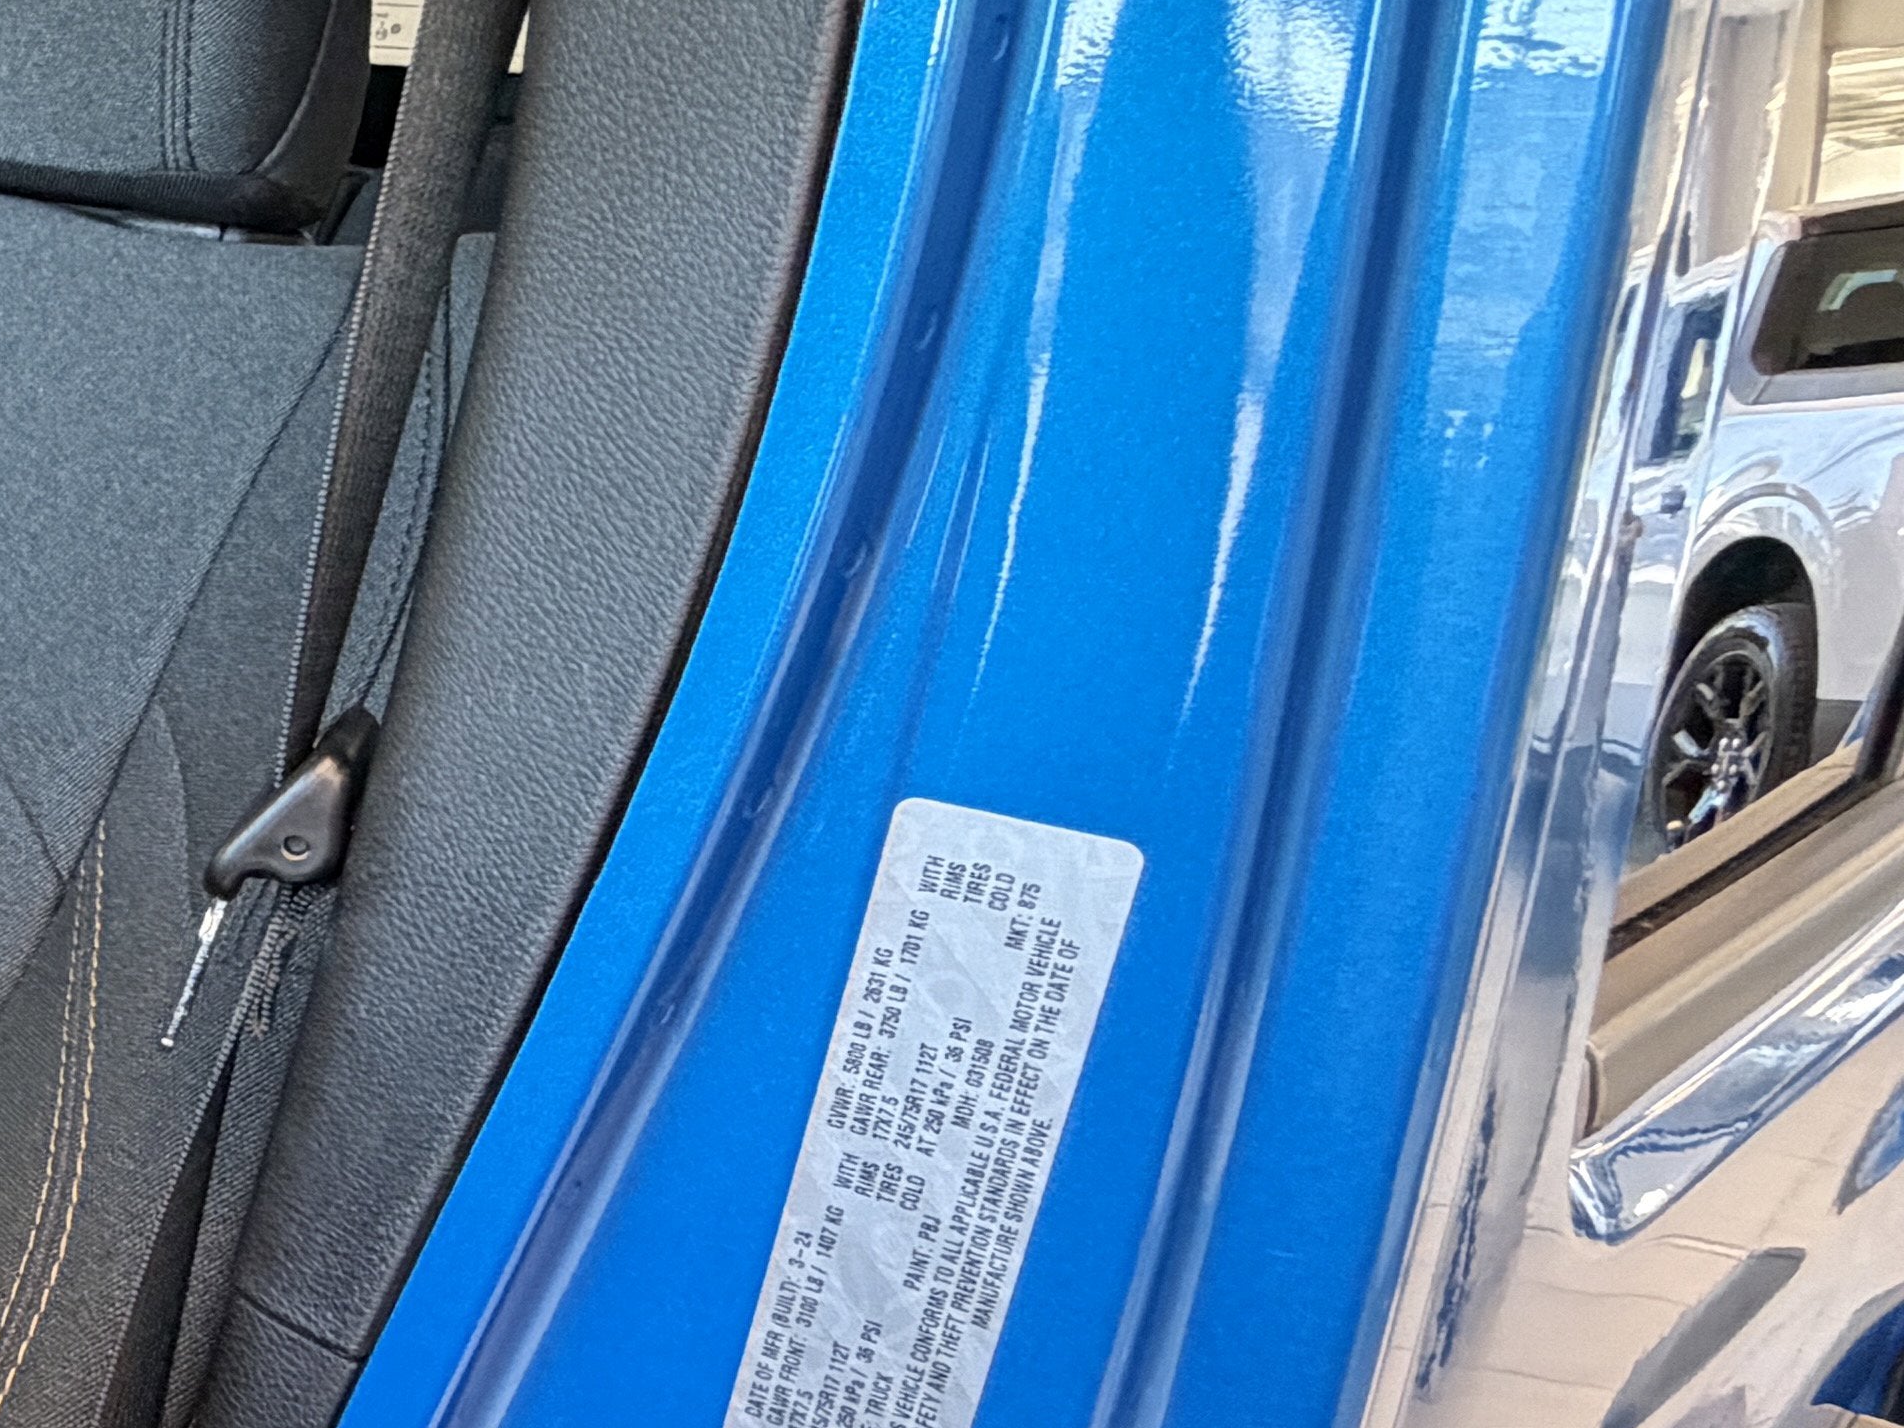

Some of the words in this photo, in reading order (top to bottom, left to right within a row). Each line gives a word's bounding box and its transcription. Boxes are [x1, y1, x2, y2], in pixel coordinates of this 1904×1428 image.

[917, 853, 946, 896] WITH
[985, 870, 1016, 912] COLD
[1015, 880, 1042, 911] 875
[907, 907, 930, 930] KG
[1003, 911, 1033, 951] MKT:
[870, 945, 894, 968] KG
[897, 932, 923, 966] 1701
[1024, 915, 1061, 979] VEHICLE
[1056, 936, 1081, 961] OF
[860, 969, 887, 1004] 2631
[870, 1093, 900, 1143] 17X7.5
[939, 860, 967, 900] RIMS
[886, 982, 909, 1004] LB
[1043, 960, 1074, 1003] DATE
[876, 1003, 903, 1040] 3750
[892, 1076, 929, 1150] 245/75R17
[913, 1041, 939, 1076] 112T
[962, 860, 992, 906] TIRES
[1008, 979, 1042, 1034] MOTOR
[1033, 1003, 1061, 1036] THE
[850, 1019, 873, 1040] LB
[947, 1015, 973, 1043] PSI
[1026, 1035, 1051, 1061] ON
[841, 1039, 867, 1076] 5800
[862, 1044, 891, 1091] REAR:
[988, 1033, 1026, 1102] FEDERAL
[825, 1080, 856, 1130] GVWR:
[929, 1078, 955, 1107] kPa
[950, 1088, 980, 1130] MDH:
[1009, 1062, 1043, 1117] EFFECT
[849, 1090, 878, 1137] GAWR
[921, 1106, 946, 1135] 250
[974, 1102, 1005, 1149] U.S.A.
[1003, 1116, 1027, 1136] IN
[914, 1134, 938, 1158] AT
[832, 1150, 860, 1191] WITH
[854, 1159, 880, 1198] RIMS
[976, 1135, 1020, 1225] STANDARDS
[948, 1149, 991, 1236] APPLICABLE
[822, 1203, 845, 1226] KG
[917, 1212, 942, 1243] PBJ
[970, 1223, 1018, 1330] MANUFACTURE
[1002, 1167, 1036, 1224] SHOWN
[1020, 1112, 1053, 1167] ABOVE.
[786, 1228, 813, 1270] 3-24
[813, 1225, 838, 1259] 1407
[938, 1234, 964, 1265] ALL
[803, 1273, 825, 1295] LB
[827, 1340, 852, 1374] 112T
[875, 1160, 904, 1206] TIRES
[903, 1243, 933, 1292] PAINT:
[931, 1263, 956, 1287] TO
[949, 1223, 993, 1313] PREVENTION
[769, 1272, 803, 1330] (BUILT):
[841, 1375, 866, 1405] kPa
[859, 1317, 883, 1345] PSI
[897, 1172, 925, 1213] COLD
[793, 1293, 819, 1329] 3100
[908, 1284, 949, 1365] CONFORMS
[760, 1328, 785, 1361] MFR
[935, 1312, 966, 1359] THEFT
[754, 1359, 776, 1383] OF
[778, 1332, 808, 1384] FRONT:
[925, 1358, 952, 1394] AND
[744, 1380, 770, 1419] DATE
[766, 1383, 793, 1428] GAWR
[864, 1370, 895, 1419] TRUCK
[892, 1362, 926, 1422] VEHICLE
